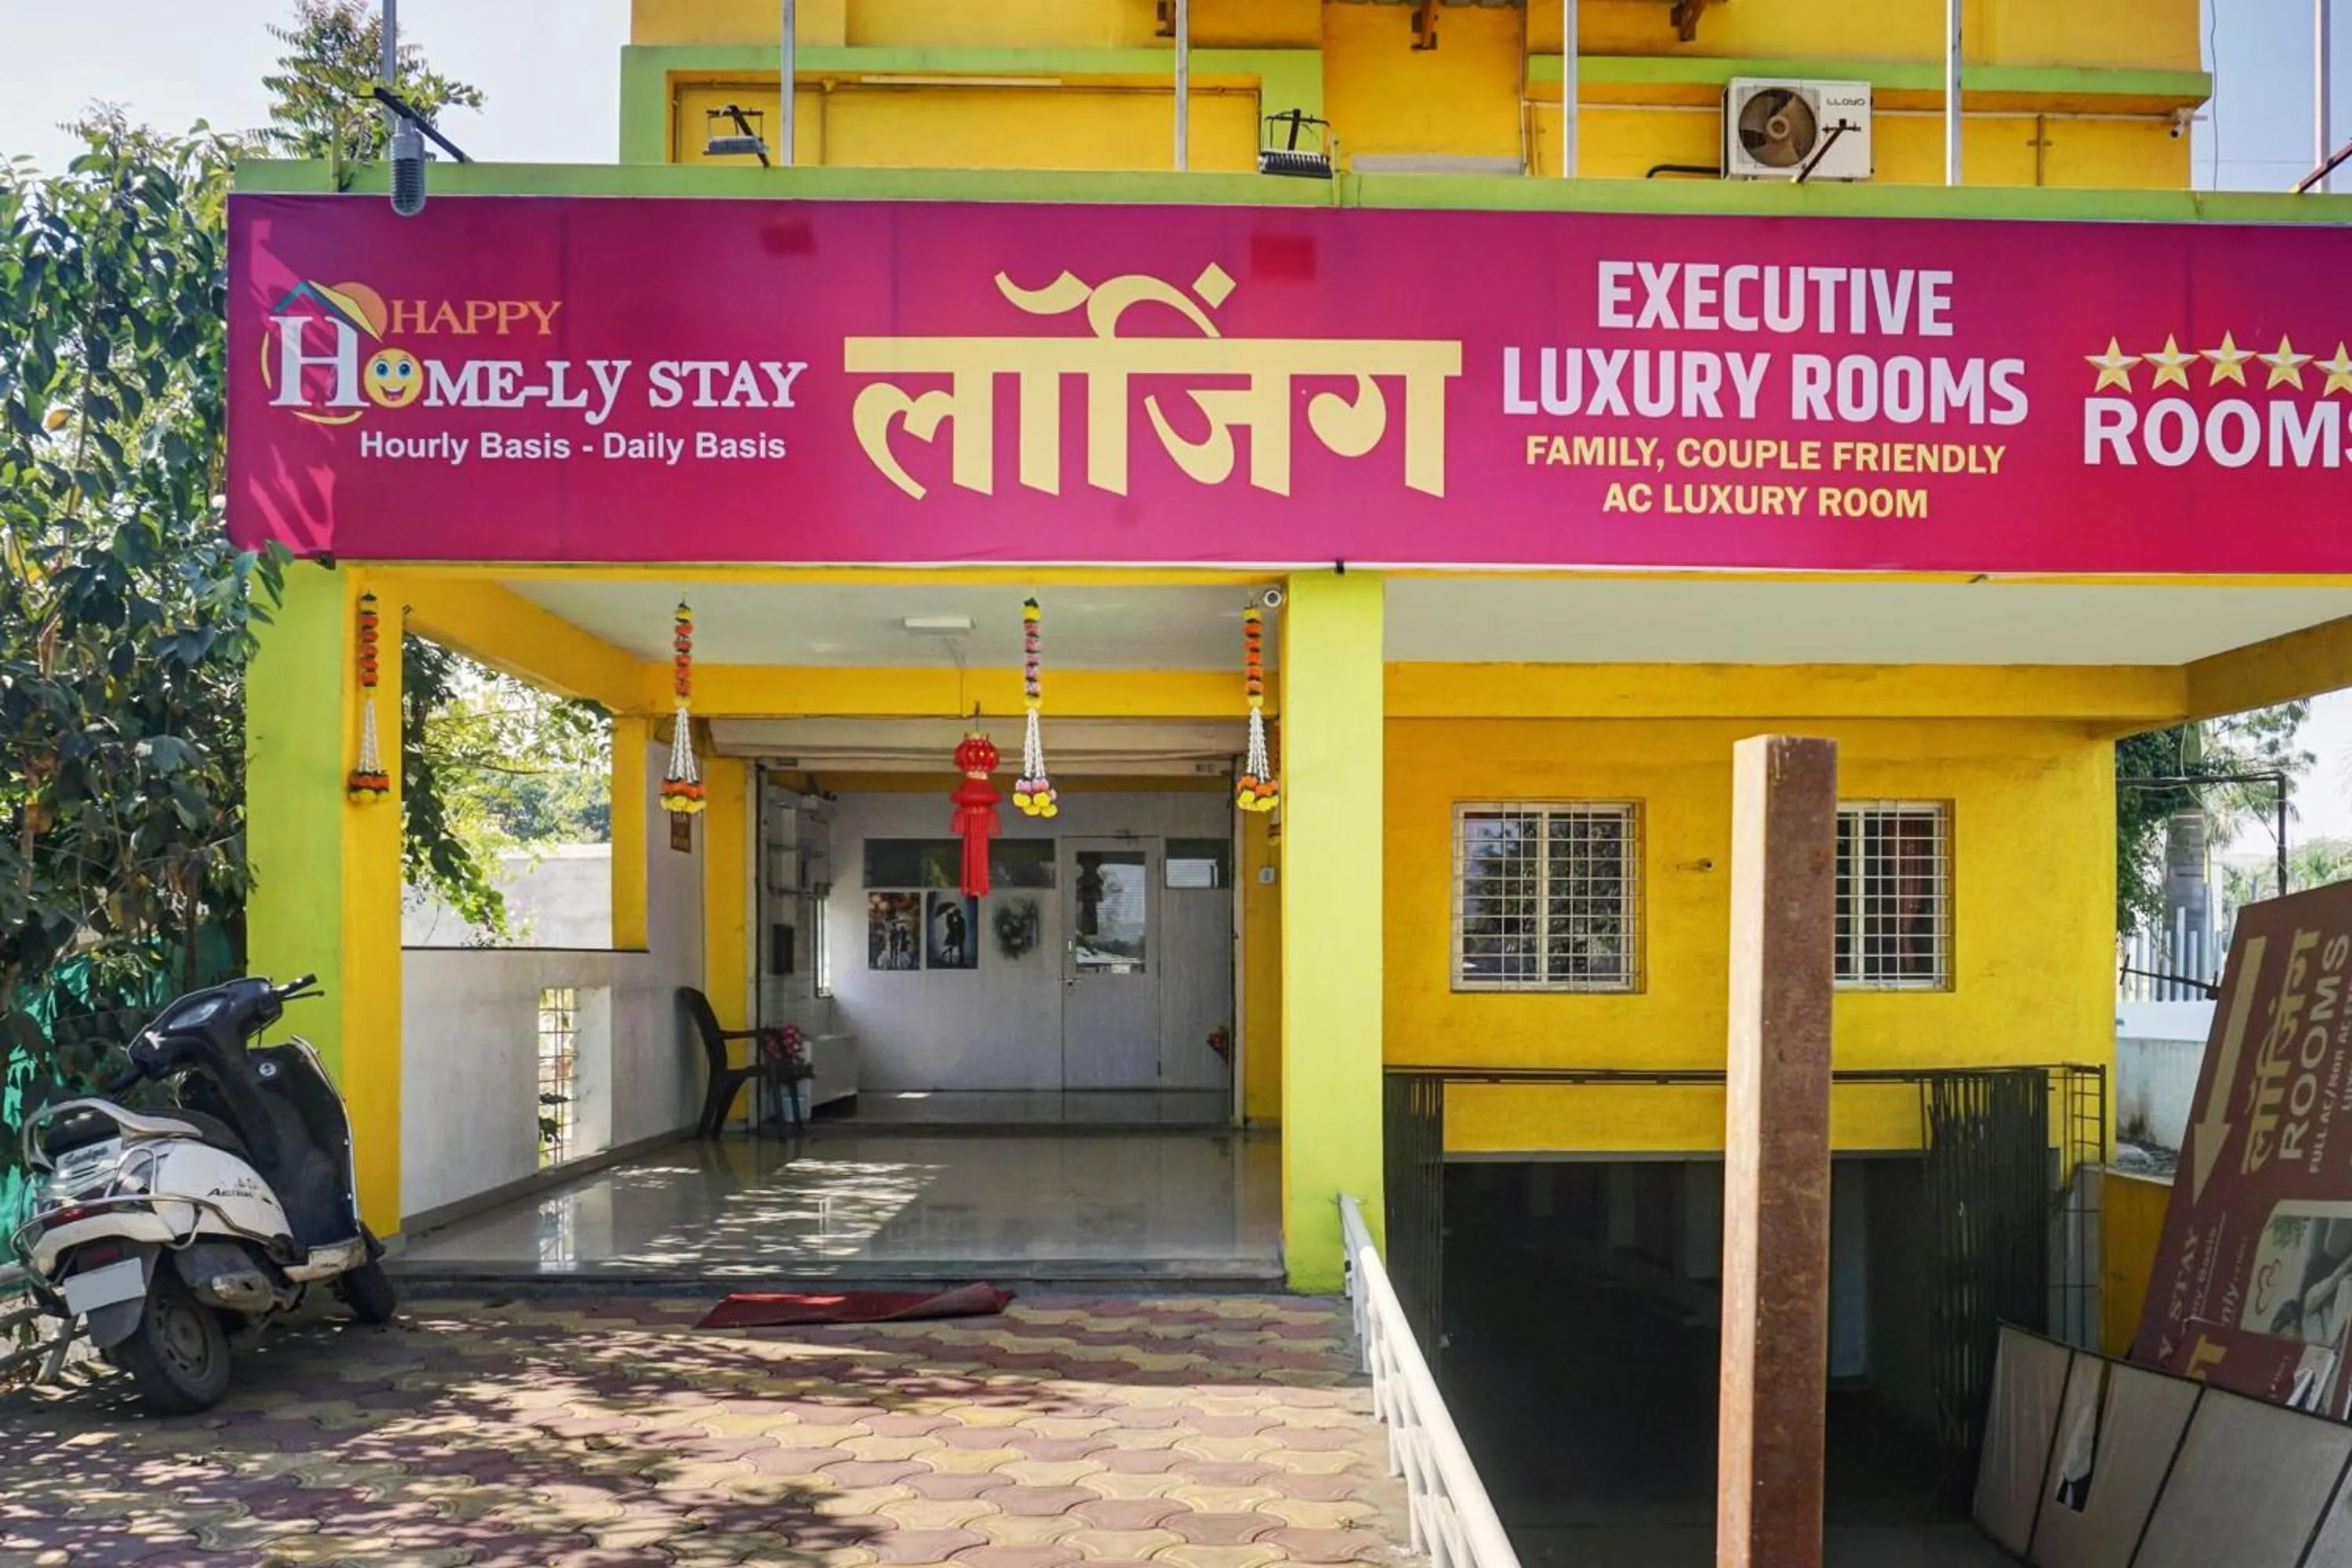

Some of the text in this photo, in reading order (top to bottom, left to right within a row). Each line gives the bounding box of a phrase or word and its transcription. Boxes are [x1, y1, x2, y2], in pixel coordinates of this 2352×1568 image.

[391, 299, 562, 335] HAPPY
[1599, 260, 1953, 336] EXECUTIVE
[648, 360, 808, 408] STAY
[844, 263, 1462, 500] लॉजिंग
[1503, 347, 2029, 426] LUXURY ROOMS
[361, 430, 470, 465] Hourly
[481, 431, 571, 459] Basis
[604, 432, 684, 465] Daily
[695, 432, 786, 459] Basis
[1526, 435, 2006, 474] FAMILY, COUPLE FRIENDLY
[2084, 397, 2352, 469] ROOM
[1602, 483, 1928, 518] AC LUXURY ROOM
[2278, 934, 2350, 1160] ROOMS
[2309, 1127, 2328, 1174] FULL
[2169, 1226, 2198, 1320] STAY
